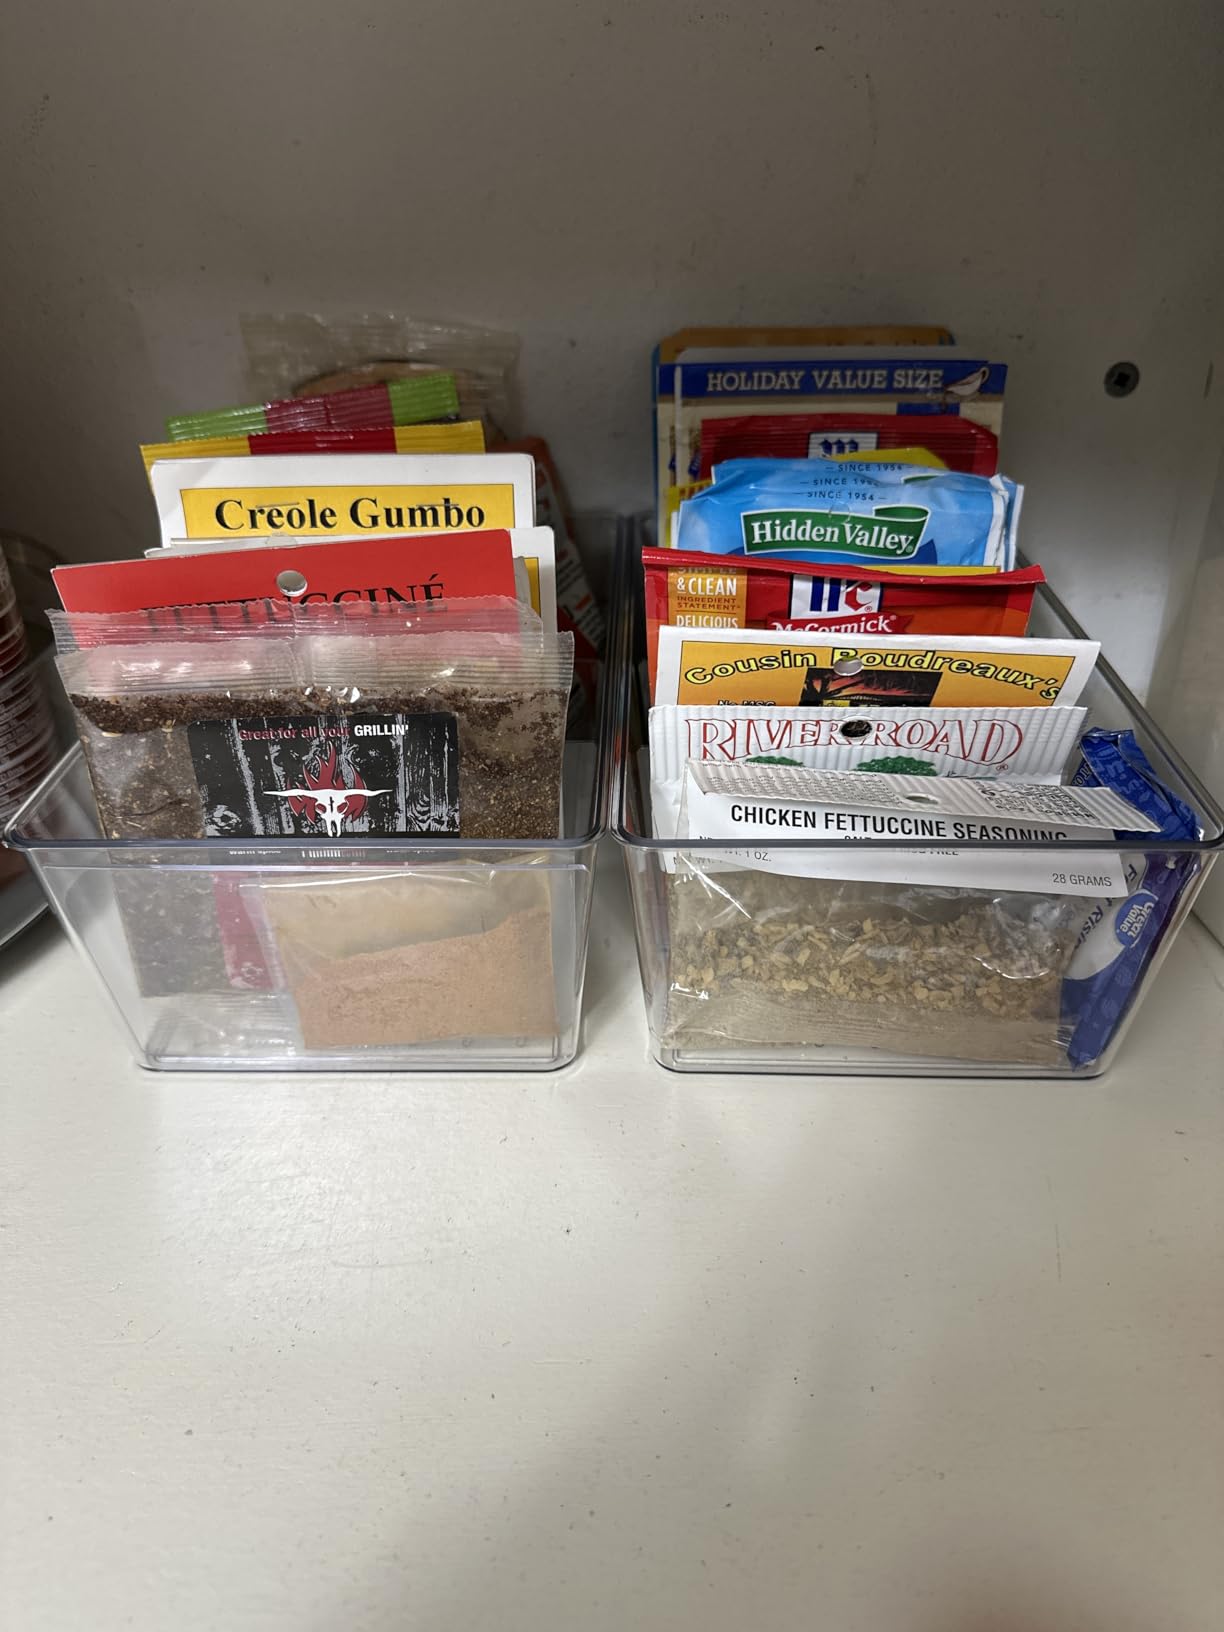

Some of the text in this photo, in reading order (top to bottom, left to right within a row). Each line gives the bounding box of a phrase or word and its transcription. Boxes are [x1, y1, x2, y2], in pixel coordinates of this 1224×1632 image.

[706, 369, 944, 392] HOLIDAY VALUE SIZE
[838, 464, 871, 472] SINCE
[813, 478, 847, 486] SINCE
[808, 491, 875, 501] SINCE 1954
[215, 496, 486, 531] Creole Gumbo
[751, 519, 914, 554] Hidden Valley
[688, 577, 737, 596] CLEAN
[677, 596, 736, 604] INGREDIENT
[676, 615, 738, 628] DELICIOUS
[770, 615, 893, 633] MCormick
[685, 650, 817, 685] Cousin
[238, 728, 276, 741] Great
[278, 727, 297, 740] for
[301, 726, 317, 738] all
[354, 724, 409, 737] GRILLIN'
[685, 718, 1024, 766] RIVER ROAD
[731, 804, 817, 829] CHICKEN
[824, 813, 947, 838] FETTUCCINE
[1052, 873, 1113, 887] 28 GRAMS
[1119, 904, 1143, 933] Value
